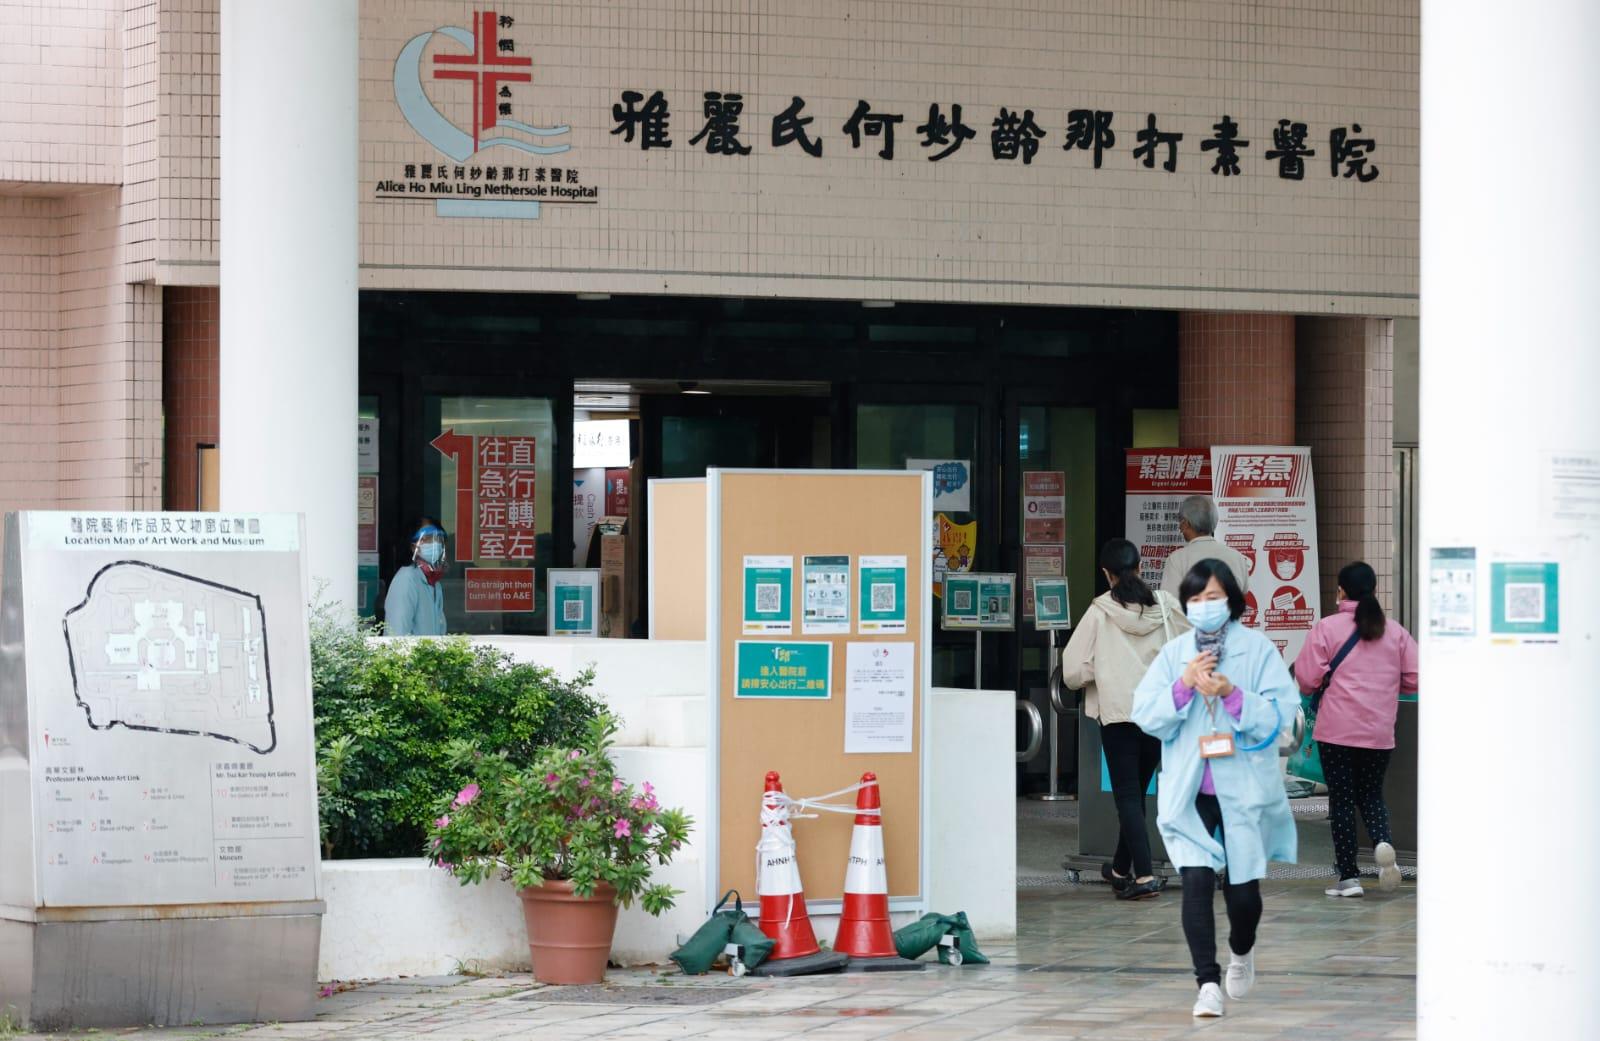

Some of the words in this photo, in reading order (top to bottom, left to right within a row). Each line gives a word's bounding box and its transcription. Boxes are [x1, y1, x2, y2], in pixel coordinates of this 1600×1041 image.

[610, 90, 1380, 183] 雅麗氏何妙齡那打素醫院
[404, 164, 579, 184] 雅麗氏何妙齡那打素醫院
[376, 181, 406, 193] Alice
[409, 182, 426, 193] Ho
[429, 182, 453, 194] Miu
[456, 183, 481, 197] Ling
[484, 184, 548, 196] Nethersole
[550, 186, 598, 199] Hospital
[1139, 455, 1204, 480] 緊急呼籲
[1232, 456, 1294, 481] 緊急
[479, 438, 506, 559] 往急症室
[508, 438, 535, 559] 直行轉左
[65, 536, 111, 545] Location
[113, 536, 136, 547] Map
[138, 536, 149, 545] of
[151, 536, 167, 545] Art
[170, 536, 198, 545] Work
[200, 536, 219, 545] and
[468, 580, 479, 590] Go
[482, 580, 512, 590] straight
[514, 580, 532, 590] then
[469, 591, 486, 600] turn
[488, 591, 501, 600] left
[503, 591, 511, 600] to
[513, 591, 531, 600] A&E
